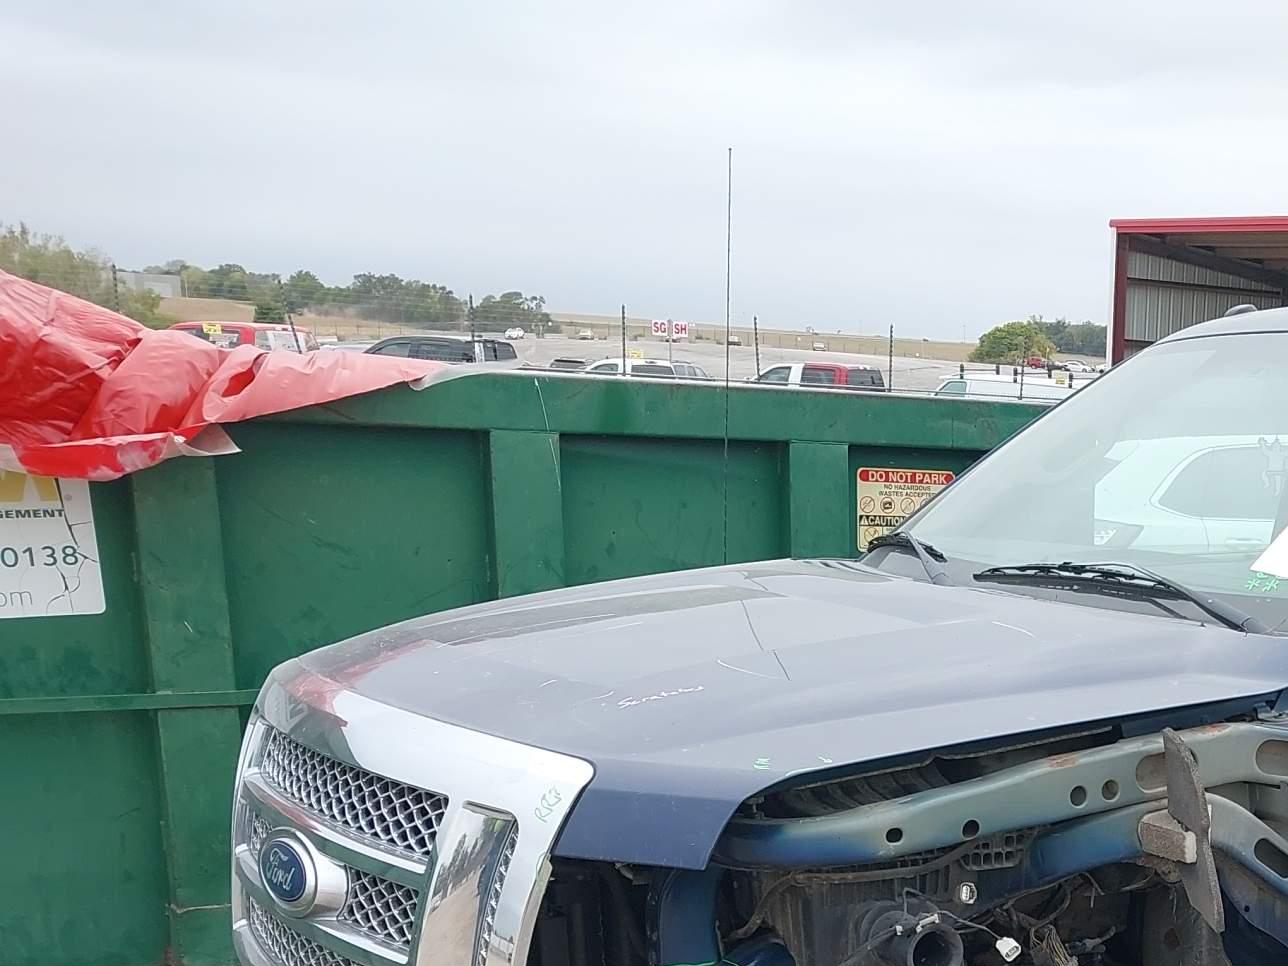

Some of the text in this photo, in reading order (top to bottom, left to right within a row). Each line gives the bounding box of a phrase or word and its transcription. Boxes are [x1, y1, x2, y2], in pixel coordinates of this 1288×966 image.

[653, 321, 667, 334] SG
[673, 323, 687, 335] SH
[869, 471, 947, 484] DO NOT PARK
[1, 545, 79, 568] 0138
[265, 847, 296, 892] Ford
